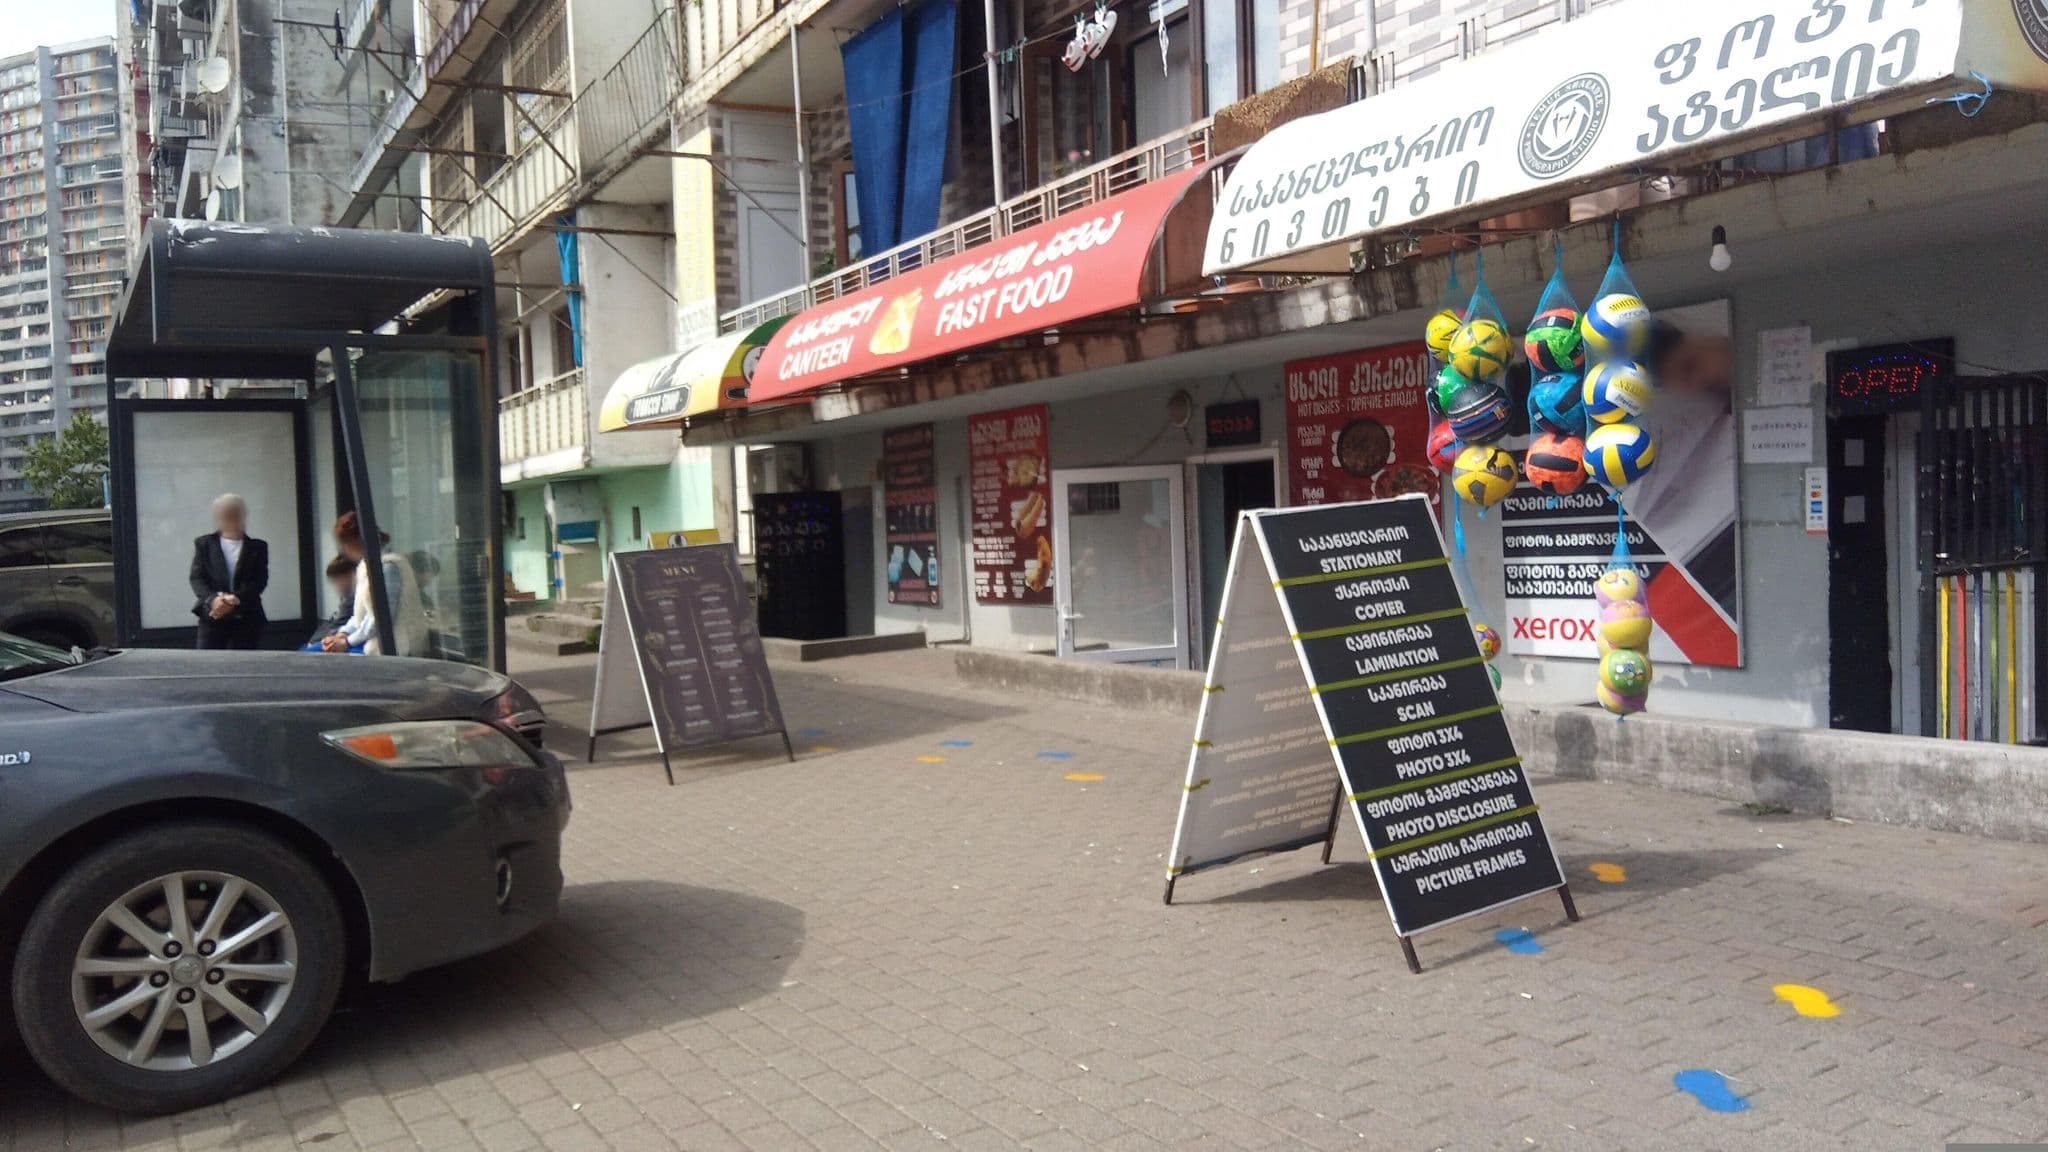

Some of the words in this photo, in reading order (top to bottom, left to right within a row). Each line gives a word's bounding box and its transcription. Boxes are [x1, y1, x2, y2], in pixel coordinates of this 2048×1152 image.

[1654, 0, 1928, 85] ფოტ
[1636, 28, 1920, 153] ატელიე
[1572, 121, 1600, 157] STUDIO
[1229, 105, 1495, 217] საკანცელარიო
[1219, 160, 1480, 264] ნივთები
[935, 287, 997, 337] FAST
[995, 263, 1074, 319] FOOD
[778, 335, 855, 381] CANTEEN
[1289, 367, 1338, 402] ცხელი
[1349, 353, 1428, 395] კერძები
[1297, 402, 1312, 417] HOT
[1312, 400, 1340, 415] DISHES
[1384, 390, 1418, 407] БЛЮДА
[1504, 493, 1604, 512] ლამინირება
[1298, 525, 1410, 552] საკანცელარიო
[1505, 535, 1554, 548] ფოტოს
[1320, 549, 1402, 573] STATIONARY
[1506, 565, 1564, 579] ფოტოს
[1334, 576, 1410, 600] ქსეროქსი
[1355, 600, 1406, 620] COPIER
[1345, 624, 1433, 652] ლამინირება
[1513, 617, 1596, 641] xerox
[1355, 646, 1439, 675] LAMINATION
[1367, 675, 1447, 703] სკანირება
[1397, 700, 1436, 722] SCAN
[1387, 730, 1437, 755] ფოტო
[1436, 726, 1463, 744] 3X4
[1396, 755, 1444, 779] PHOTO
[1445, 749, 1471, 768] 3X4
[1366, 789, 1426, 819] ფოტოს
[1426, 768, 1518, 804] გამჟღავნება
[1385, 815, 1435, 841] PHOTO
[1436, 793, 1517, 828] DISCLOSURE
[1390, 842, 1460, 874] სურათის
[1460, 821, 1533, 854] ჩარჩოები
[1415, 863, 1475, 895] PICTURE
[1474, 848, 1527, 877] FRAMES
